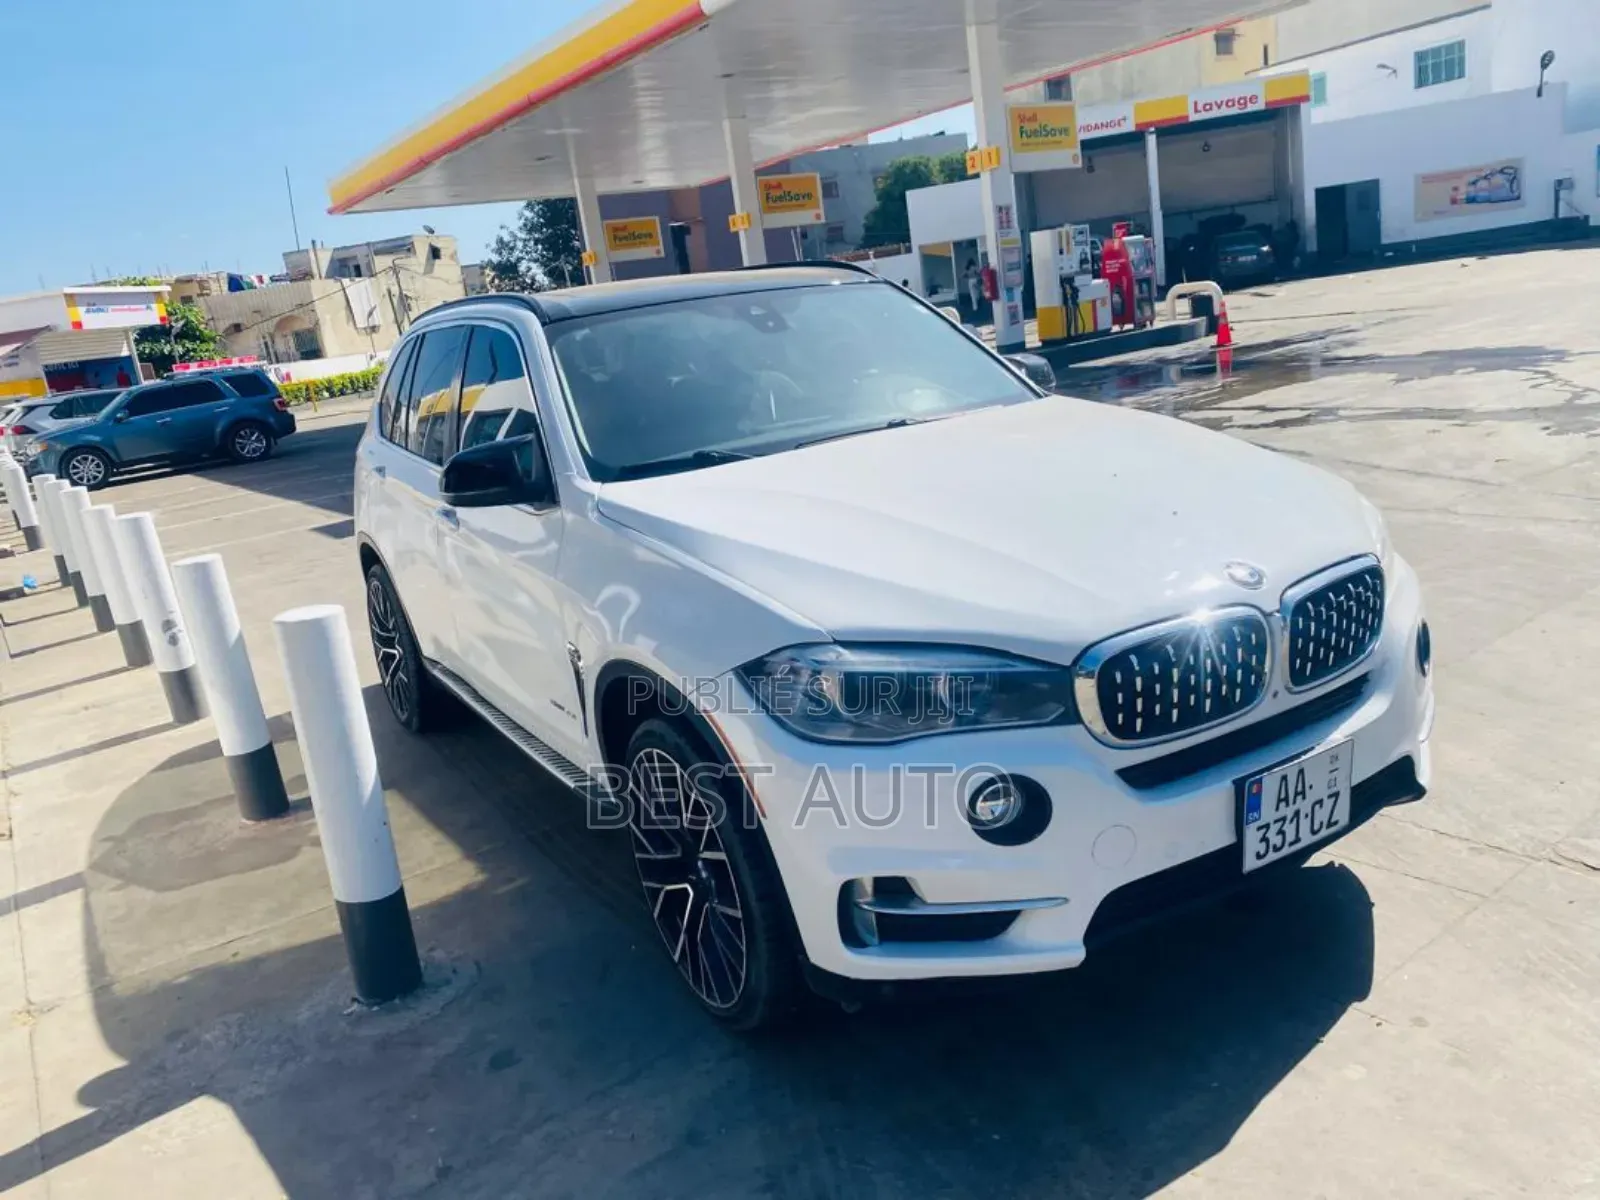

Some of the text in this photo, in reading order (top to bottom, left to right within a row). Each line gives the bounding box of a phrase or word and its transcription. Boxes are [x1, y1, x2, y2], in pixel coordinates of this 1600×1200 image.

[1193, 94, 1259, 114] Lavage
[1018, 124, 1070, 139] FuelSave
[765, 191, 813, 204] FuelSave
[1247, 810, 1260, 824] SN
